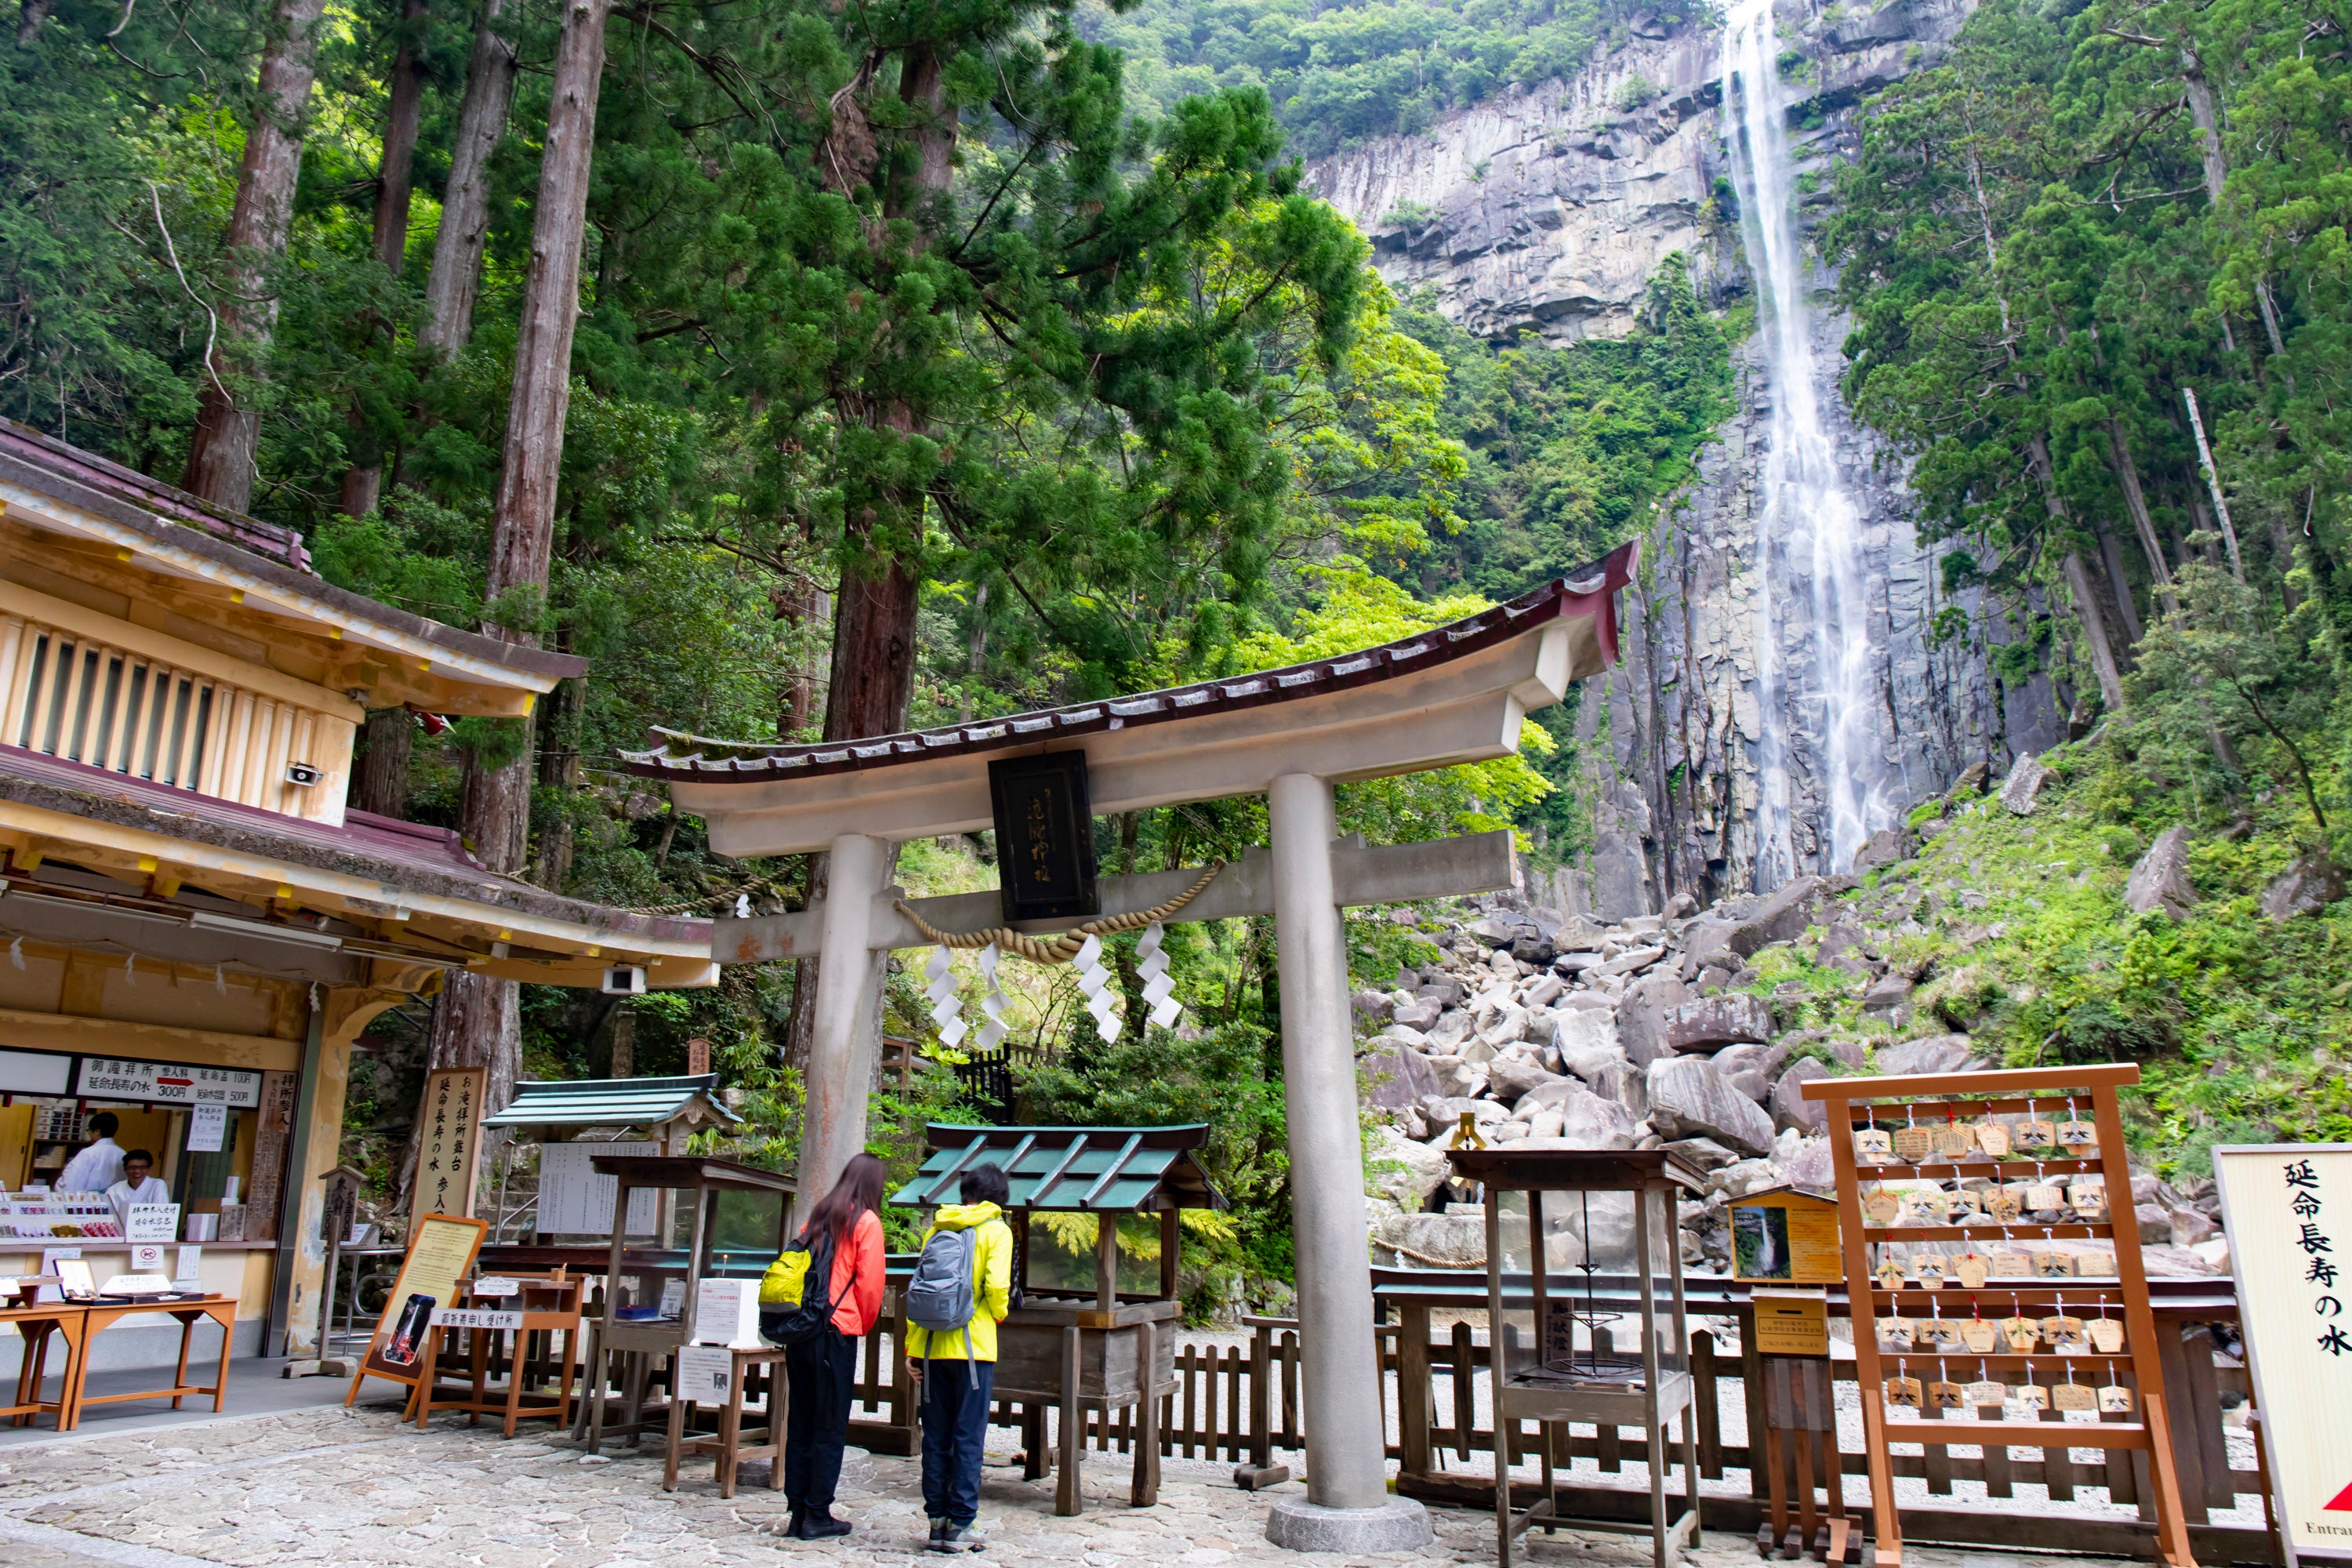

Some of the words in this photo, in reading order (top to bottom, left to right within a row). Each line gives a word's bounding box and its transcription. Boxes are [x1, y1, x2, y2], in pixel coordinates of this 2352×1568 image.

[89, 1076, 151, 1093] 延命長寿の水
[158, 1086, 186, 1098] 300円
[230, 1091, 249, 1102] 500円
[429, 1076, 451, 1172] 延命長寿の水
[452, 1076, 472, 1172] お滝拝所舞台
[434, 1177, 448, 1214] 参入
[2283, 1159, 2352, 1357] 延命長寿の水
